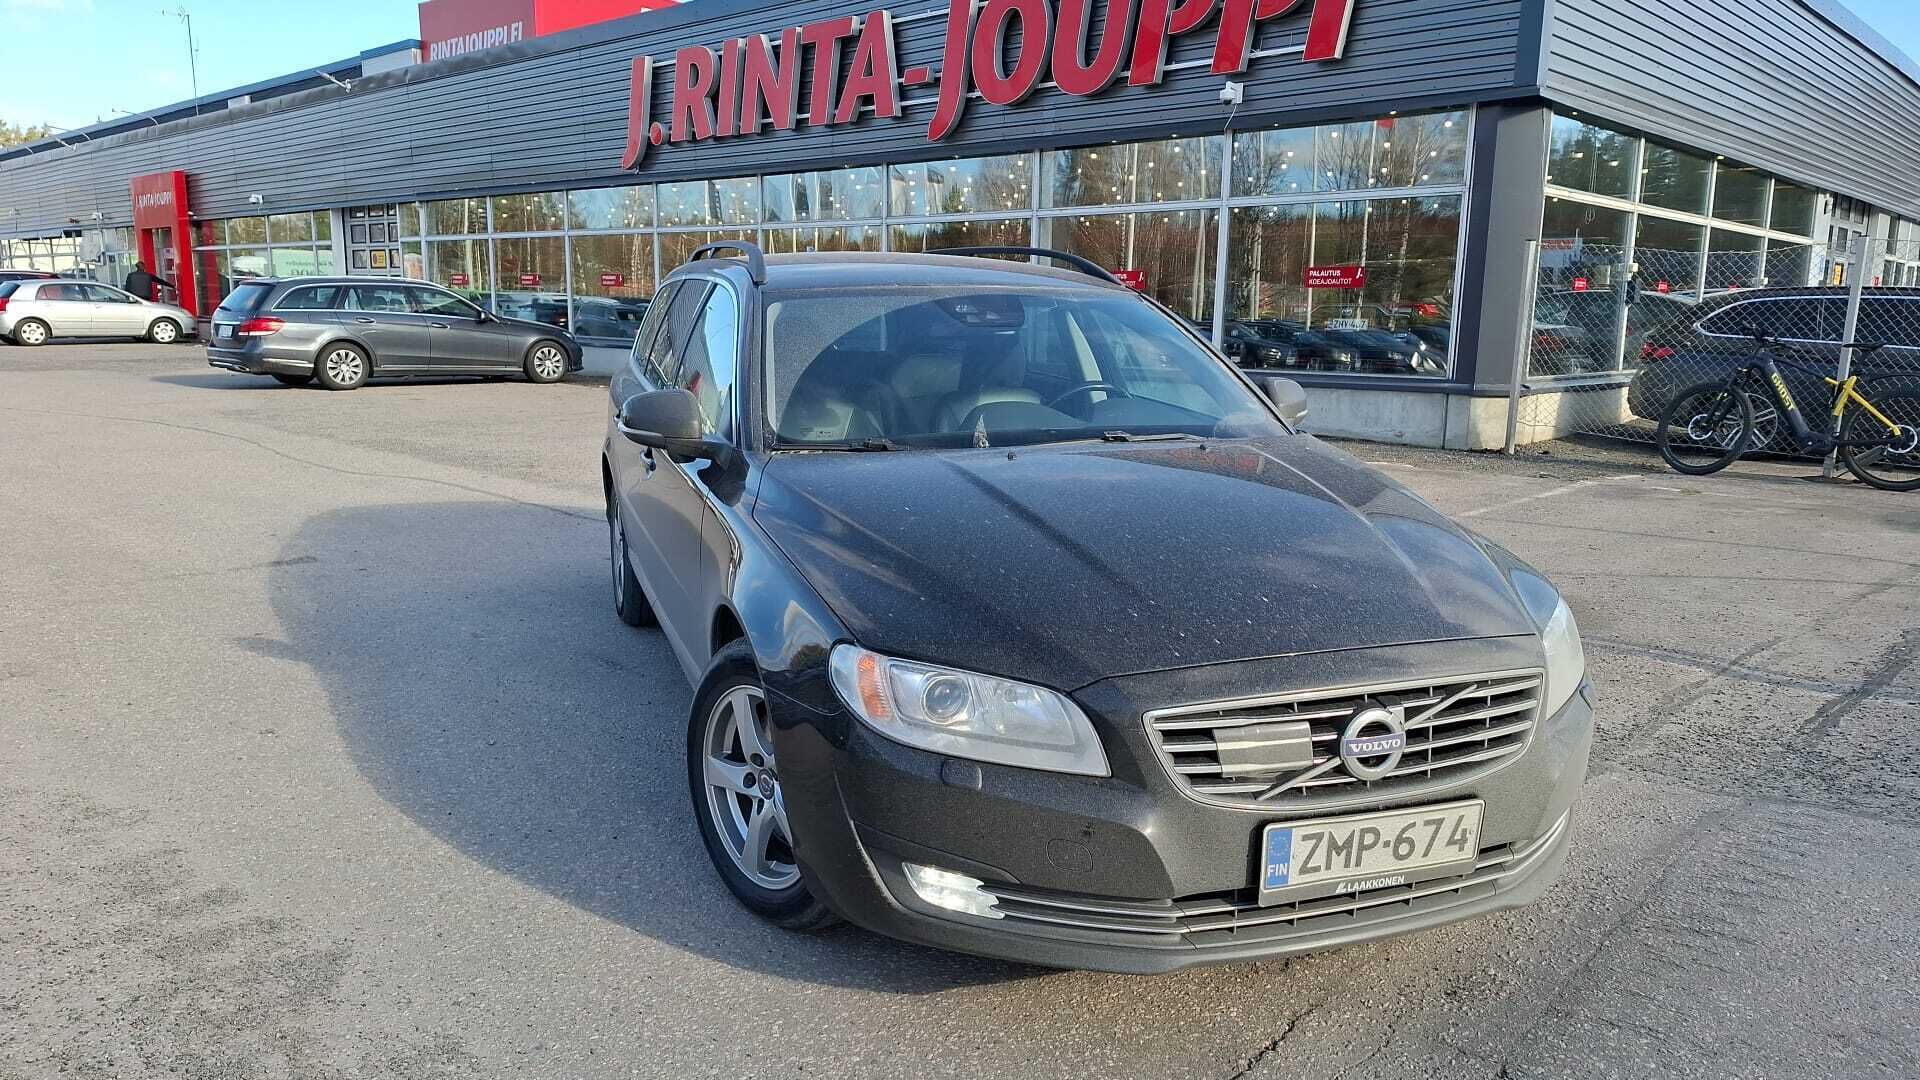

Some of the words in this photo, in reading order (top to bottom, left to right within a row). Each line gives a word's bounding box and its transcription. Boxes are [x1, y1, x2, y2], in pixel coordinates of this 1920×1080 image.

[1771, 372, 1794, 410] GHOST
[1348, 738, 1401, 753] VOLVO
[1298, 814, 1469, 876] ZMP-674
[1266, 863, 1289, 878] FIN
[1347, 874, 1405, 892] LAAKKONEN
